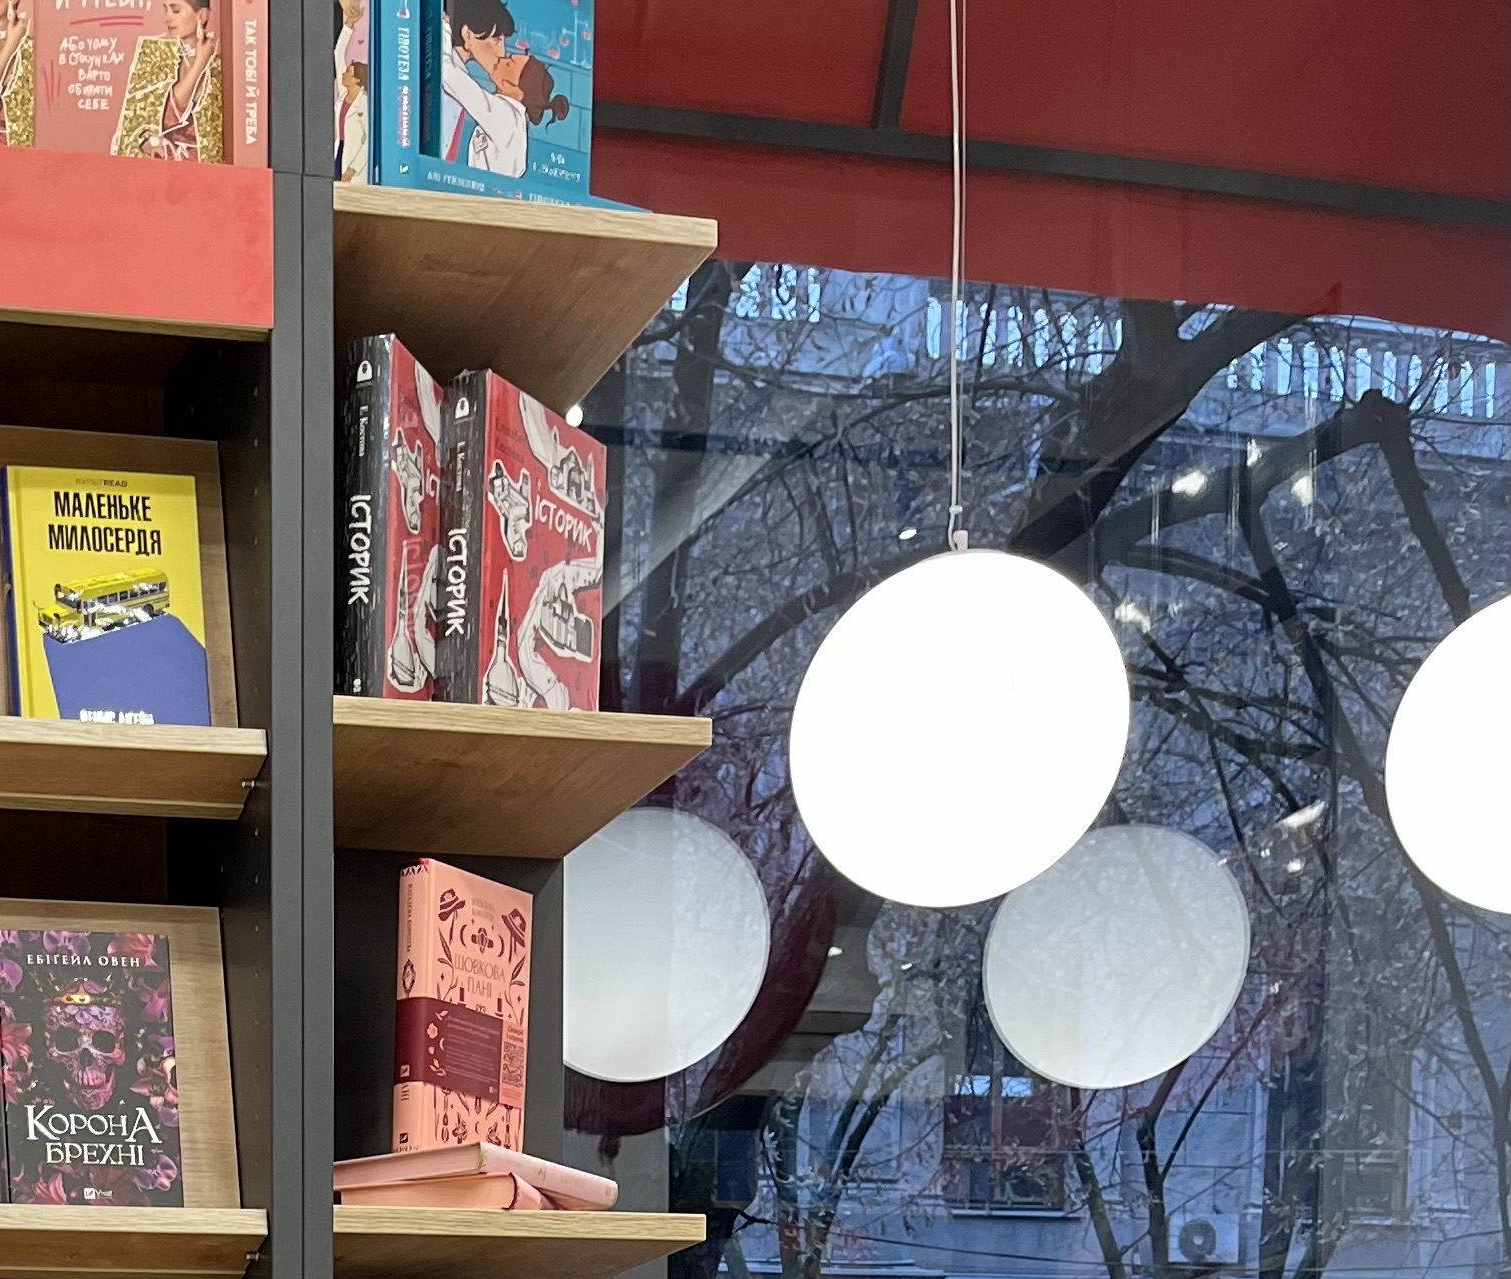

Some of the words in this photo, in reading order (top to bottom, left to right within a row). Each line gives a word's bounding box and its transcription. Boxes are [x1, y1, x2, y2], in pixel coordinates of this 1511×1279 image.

[77, 97, 110, 111] СЕБЕ
[53, 491, 152, 522] МАЛЕНЬКЕ
[534, 480, 592, 552] ІСТОРИК
[48, 524, 162, 557] МИЛОСЕРДЯ
[347, 494, 372, 605] ІСТОРИК
[444, 528, 468, 637] ІСТОРИК
[98, 956, 140, 968] ОВЕН
[454, 953, 506, 984] ШОВКОВА
[467, 975, 493, 999] ПАНІ
[25, 1104, 162, 1144] КОРОНА
[45, 1142, 145, 1166] БРЕХНІ
